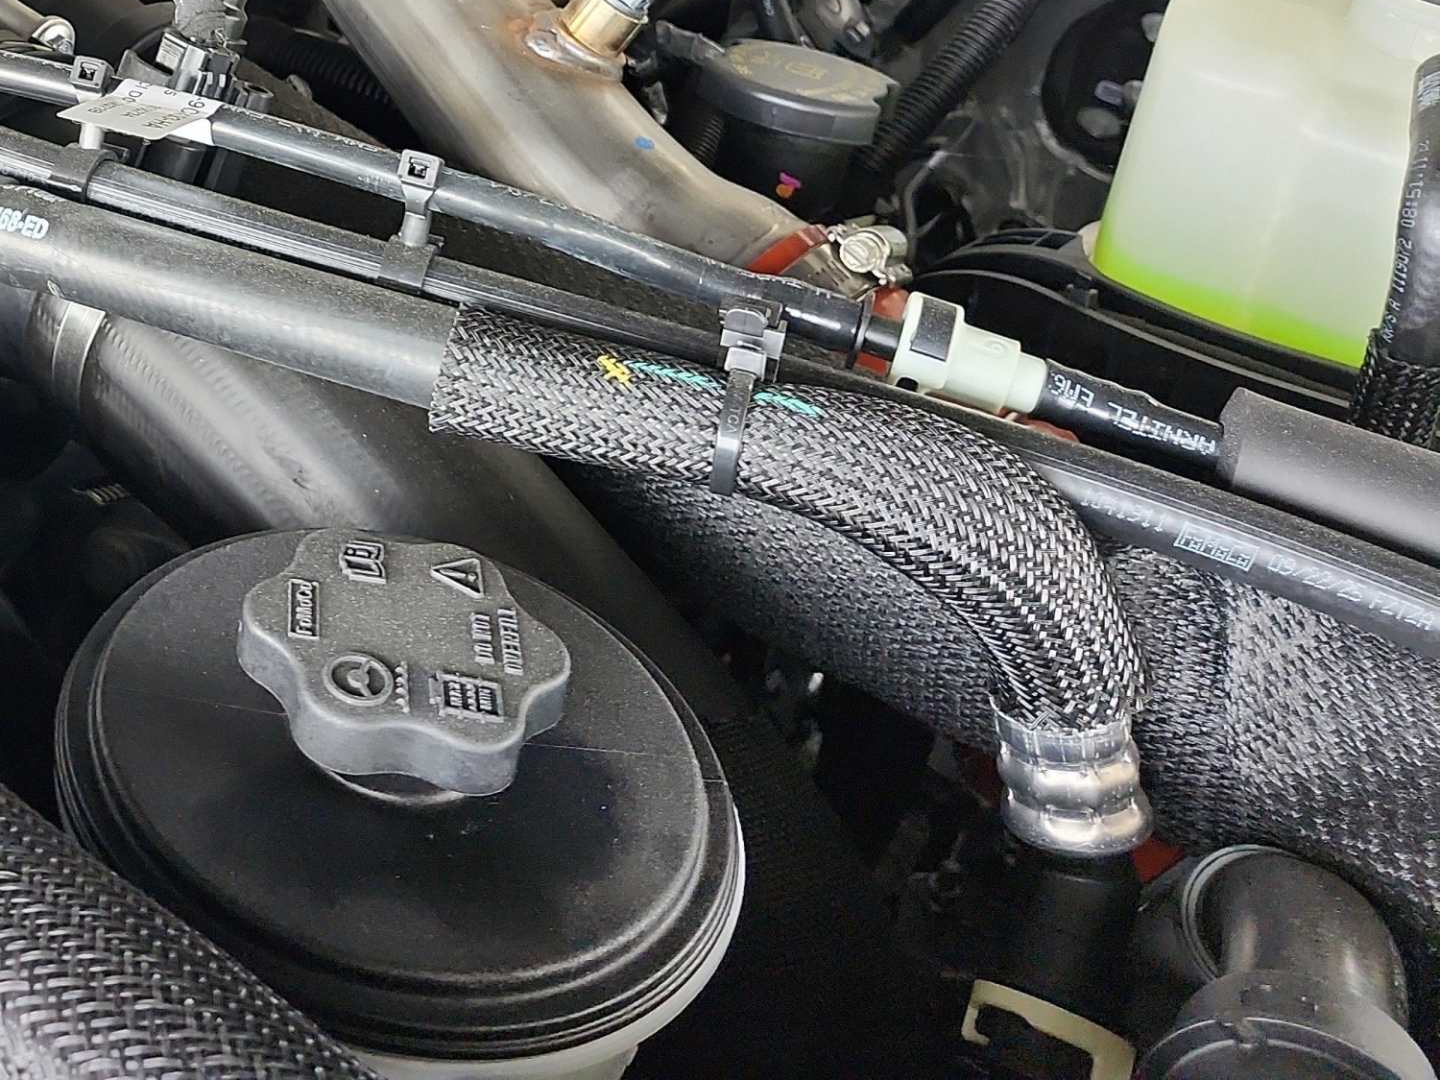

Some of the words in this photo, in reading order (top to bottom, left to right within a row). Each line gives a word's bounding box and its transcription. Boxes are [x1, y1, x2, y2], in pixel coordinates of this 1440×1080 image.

[1107, 401, 1217, 456] ARNITEL
[294, 581, 314, 636] FoMoCo
[473, 642, 496, 665] DO
[497, 608, 524, 676] OVERFILL
